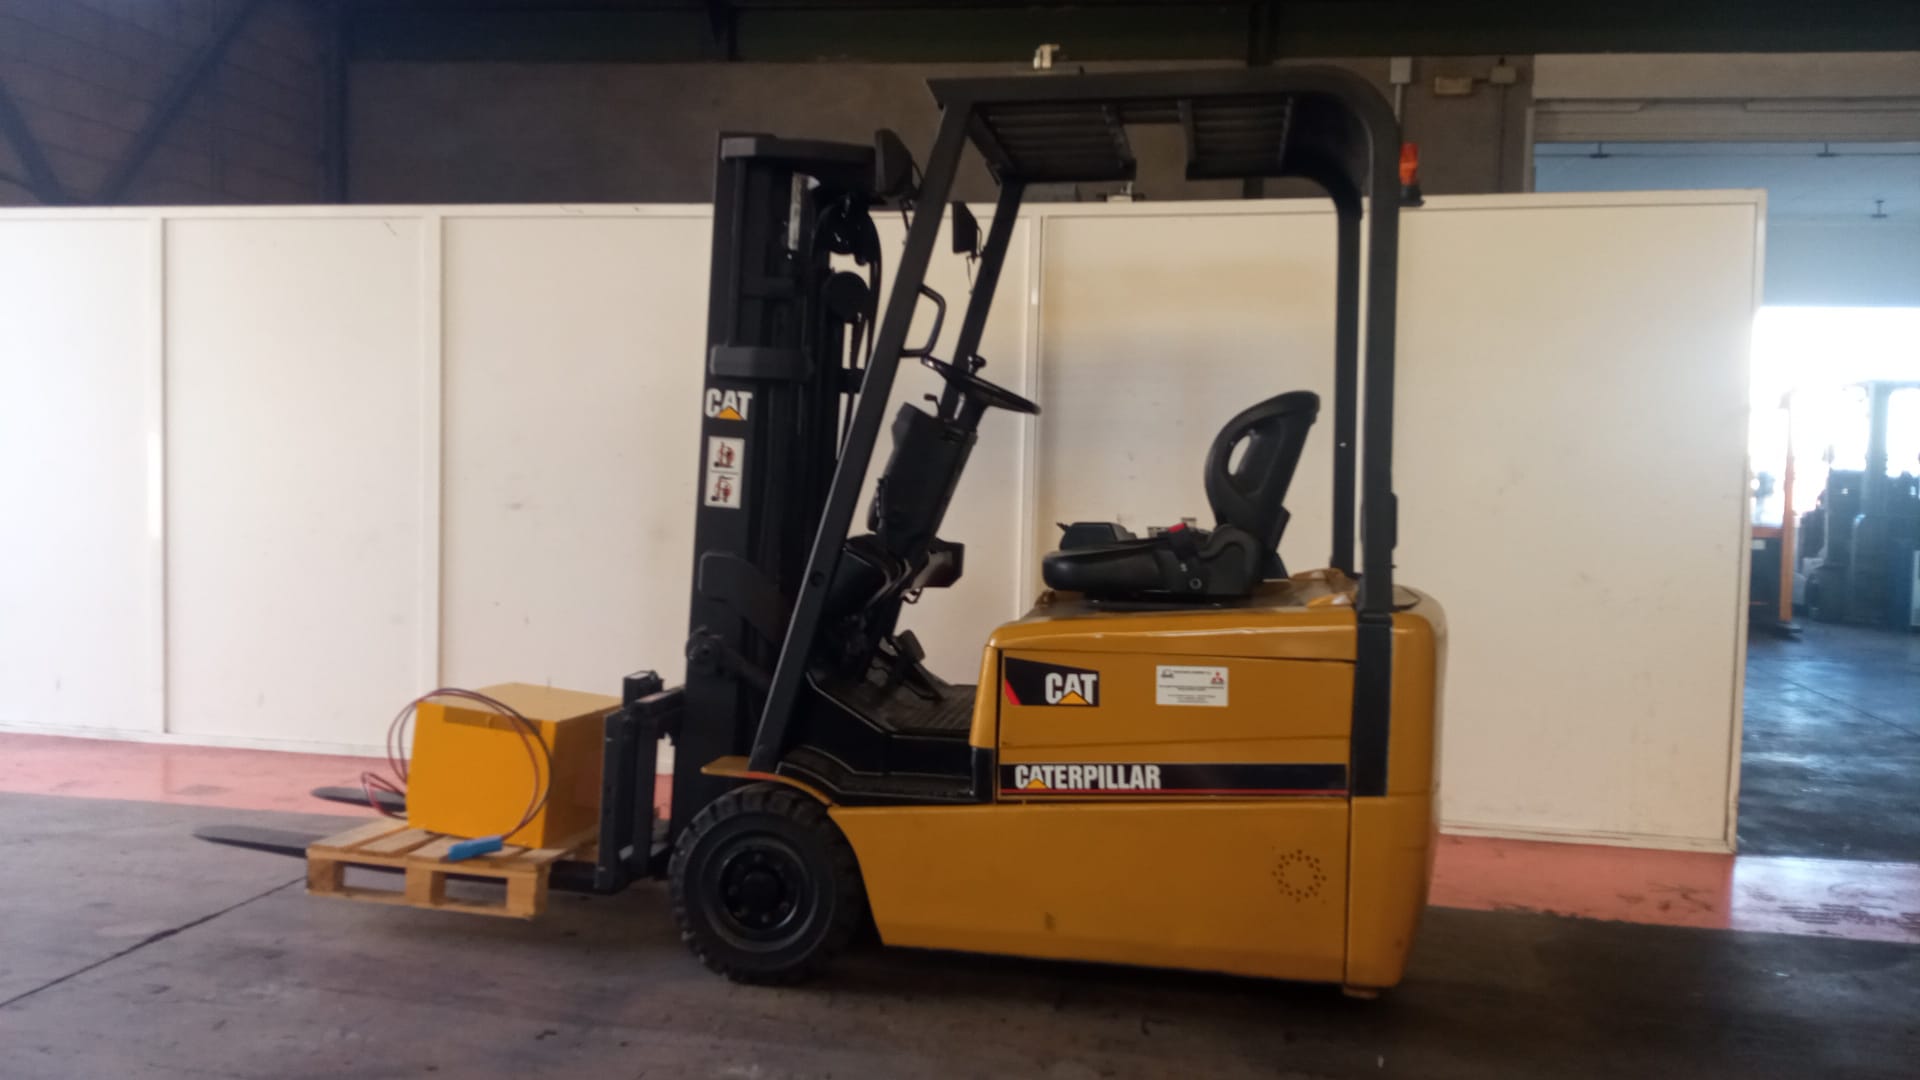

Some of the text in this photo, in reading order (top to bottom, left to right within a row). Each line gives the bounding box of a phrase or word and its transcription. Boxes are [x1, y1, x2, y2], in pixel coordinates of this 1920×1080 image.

[705, 388, 753, 421] CAT
[1045, 673, 1098, 705] CAT
[1015, 765, 1161, 789] CATERPILLAR
